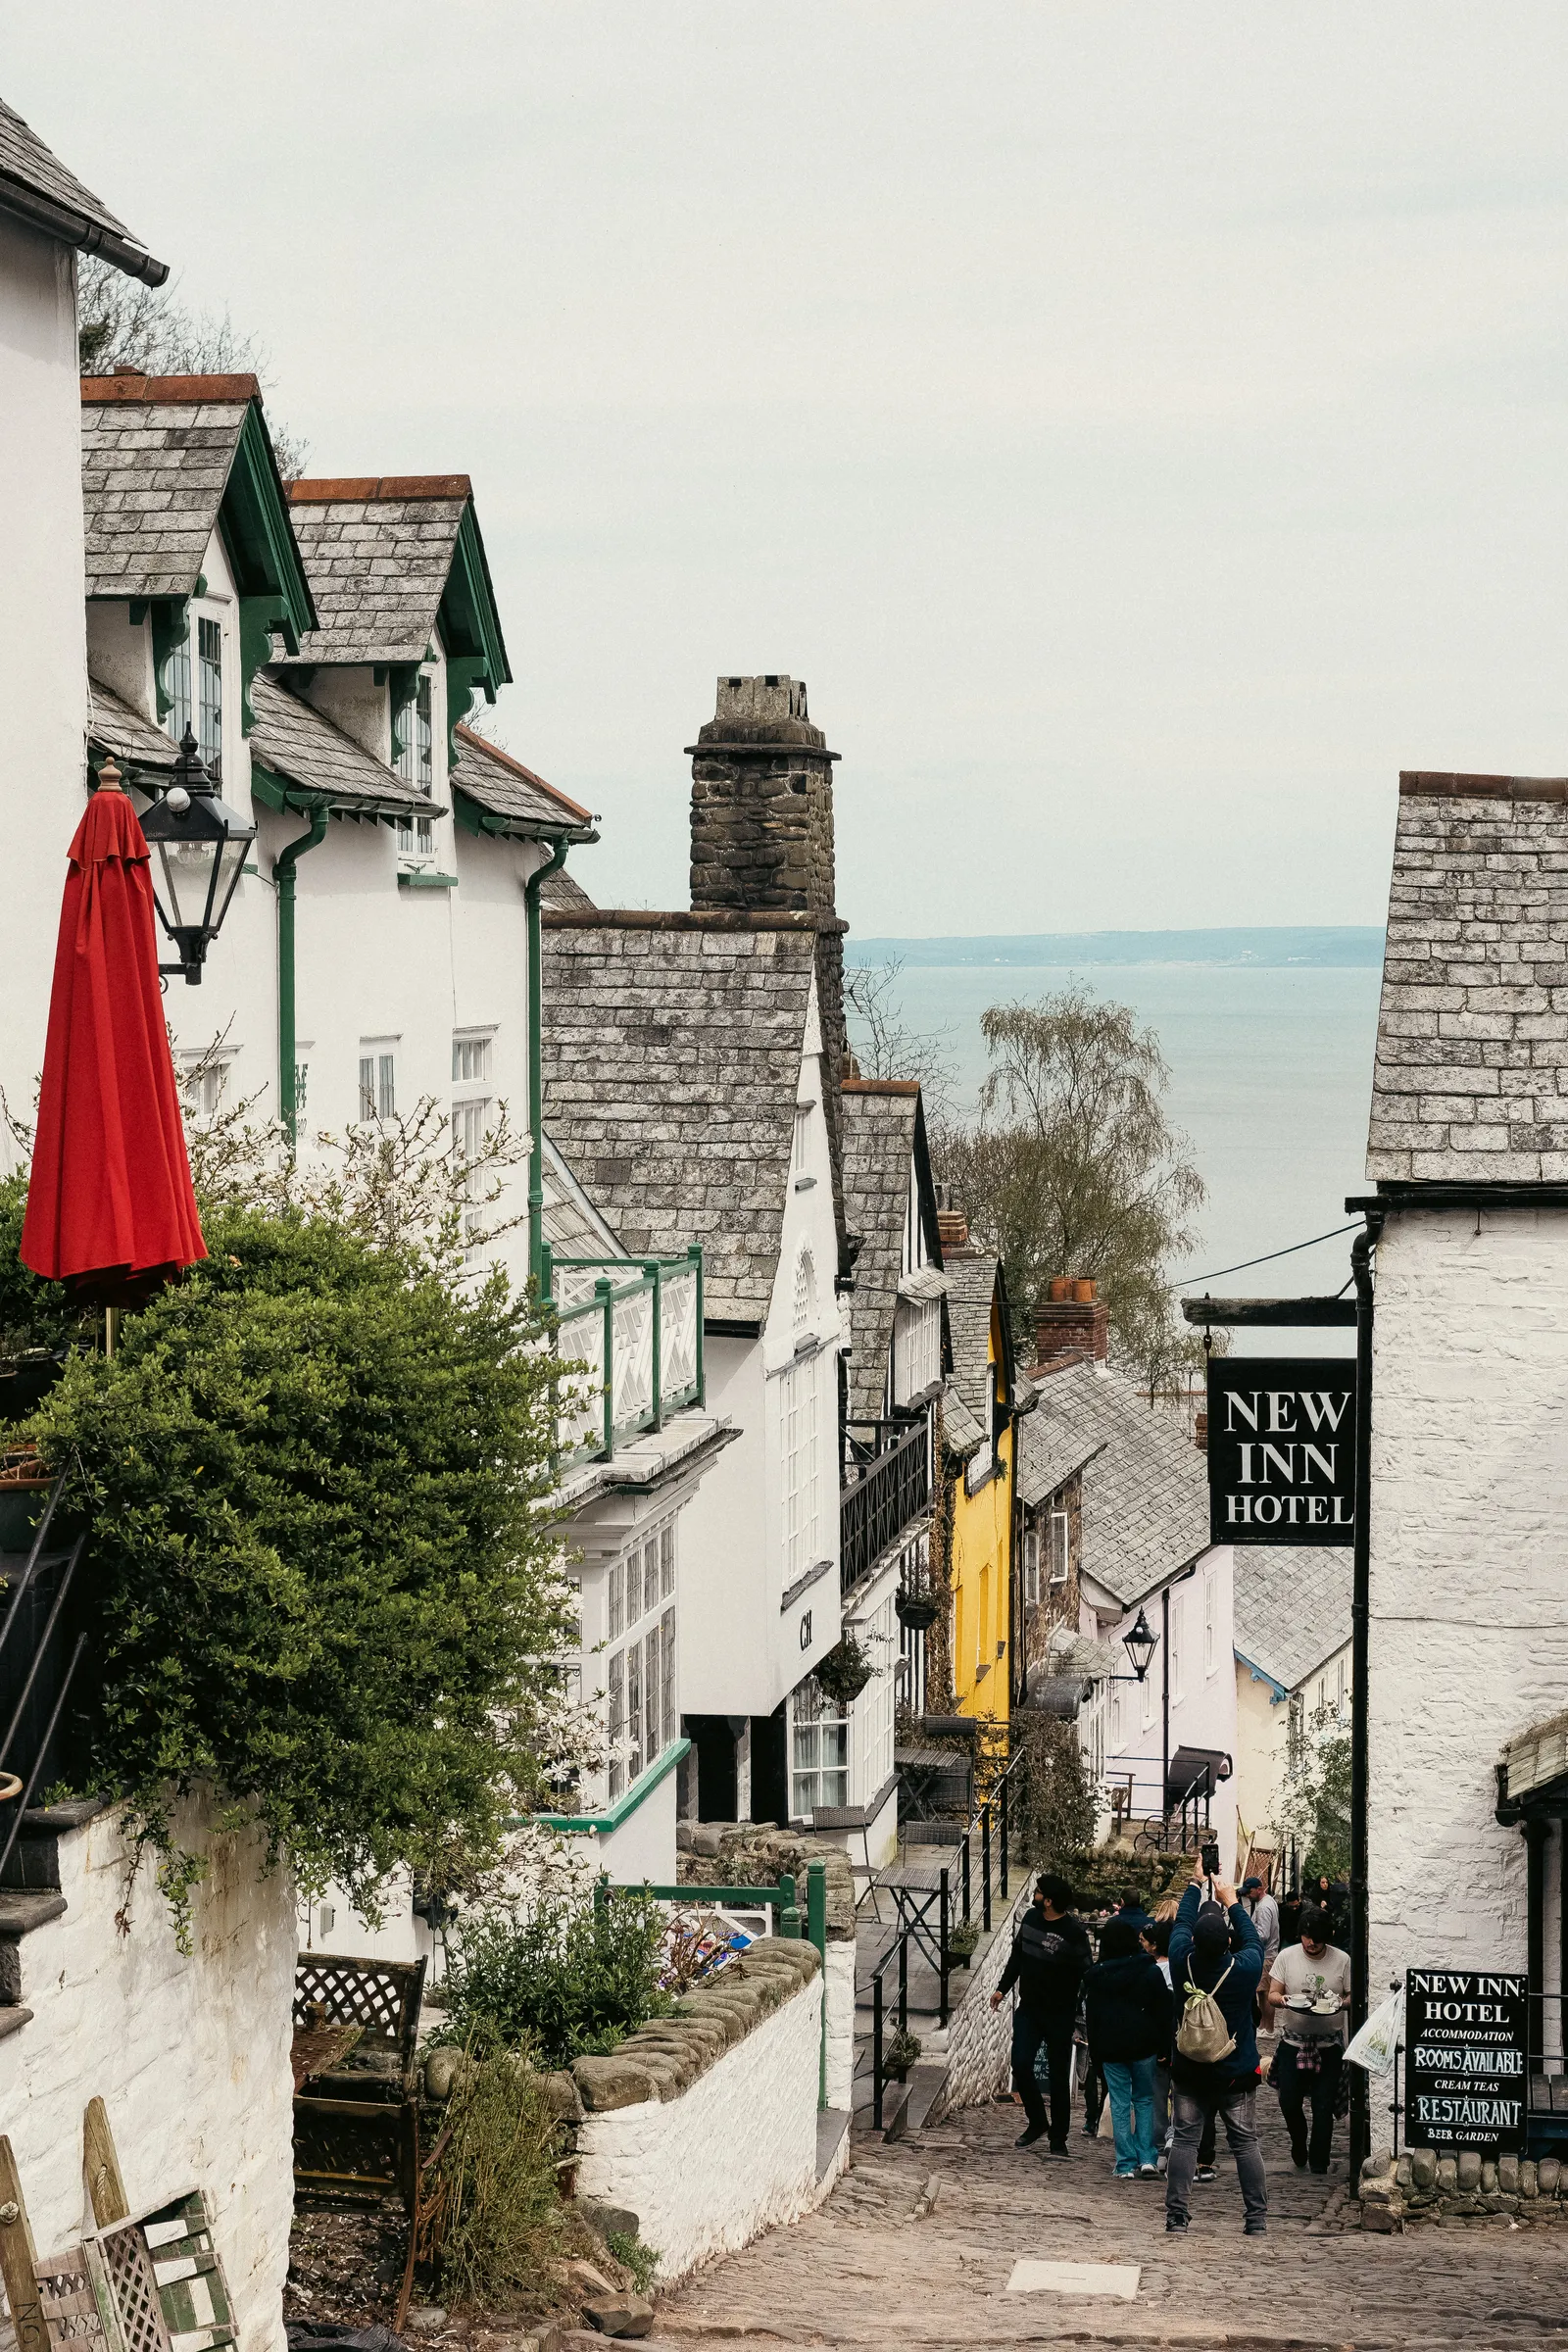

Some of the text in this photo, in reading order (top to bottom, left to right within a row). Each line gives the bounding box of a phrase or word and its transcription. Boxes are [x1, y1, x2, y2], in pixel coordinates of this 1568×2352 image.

[1223, 1391, 1352, 1432] NEW
[1237, 1443, 1340, 1484] INN
[1225, 1494, 1354, 1525] HOTEL
[1414, 1974, 1521, 1997] NEW INN
[1424, 2001, 1510, 2023] HOTEL
[1420, 2028, 1514, 2041] ACCOMMODATION
[1413, 2046, 1461, 2070] ROOMS
[1461, 2050, 1523, 2074] AVAILABLE
[1434, 2079, 1499, 2092] CREAM TEAS
[1417, 2097, 1522, 2126] RESTAURANT
[1428, 2128, 1499, 2142] BEER GARDEN
